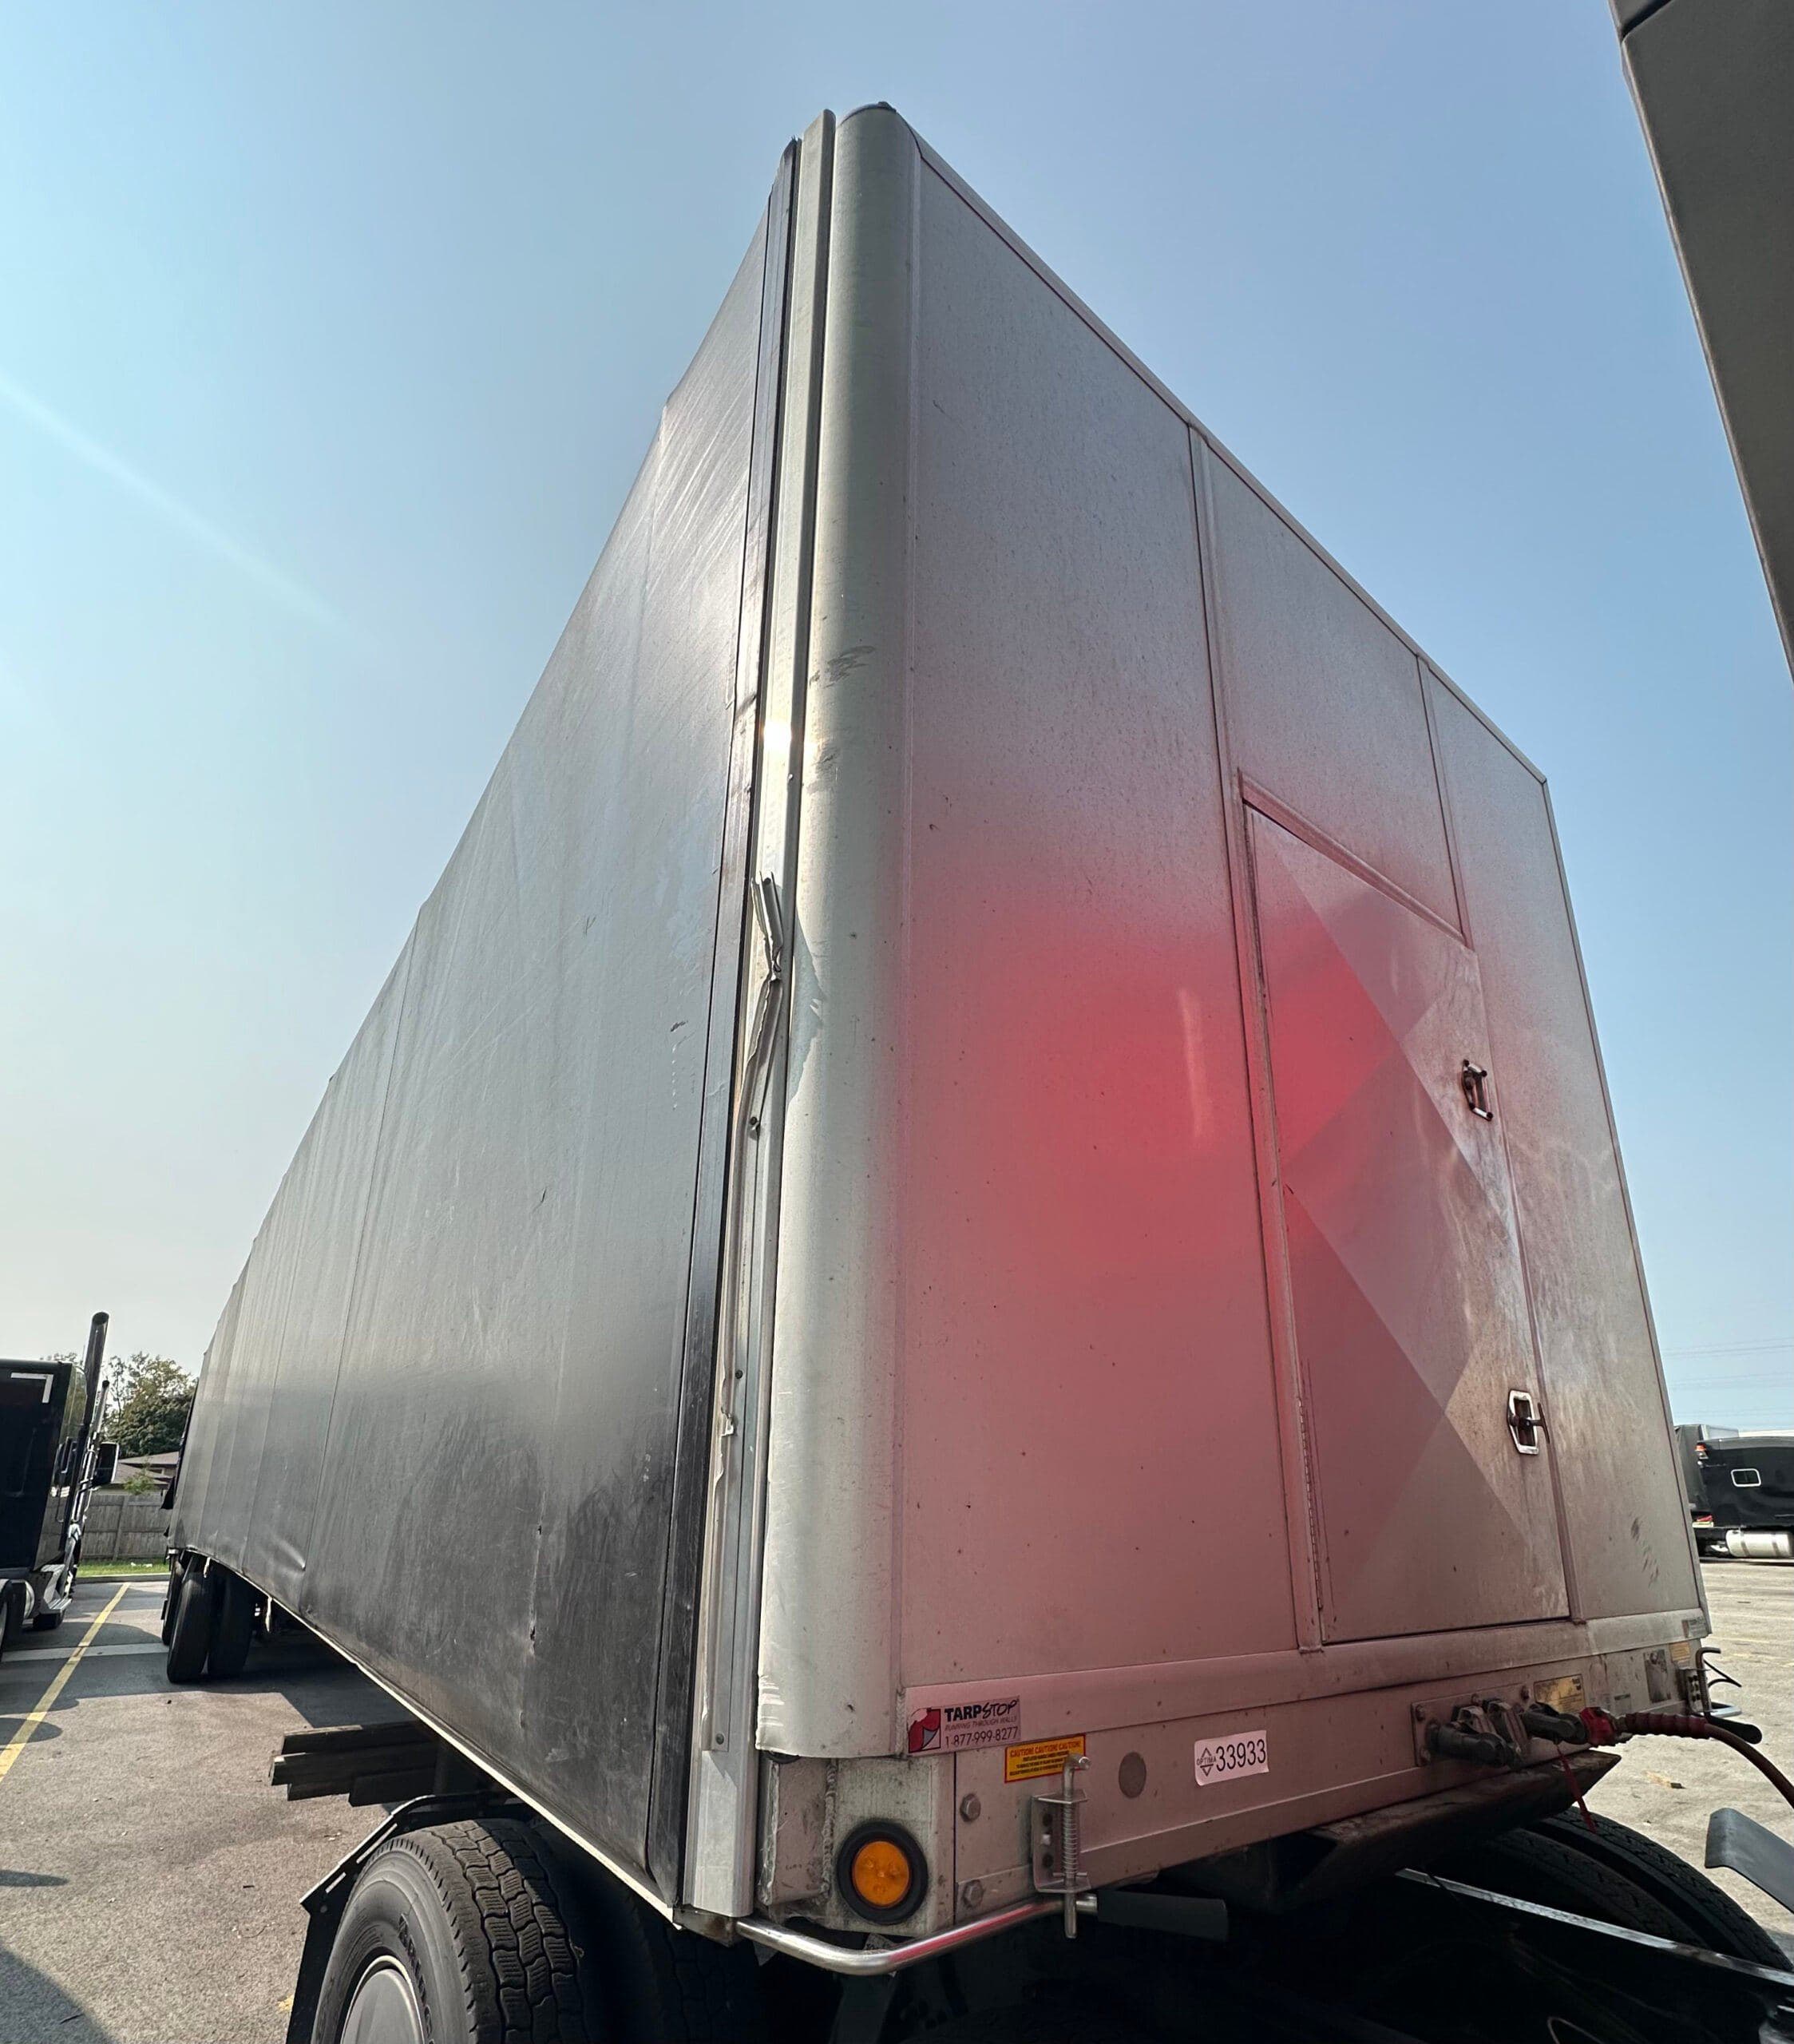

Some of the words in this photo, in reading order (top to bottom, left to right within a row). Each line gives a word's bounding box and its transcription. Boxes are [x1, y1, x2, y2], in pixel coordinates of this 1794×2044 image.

[945, 1726, 1018, 1749] 1-877-999-8277
[1196, 1755, 1216, 1765] OPTIMA
[1216, 1739, 1266, 1772] 33933
